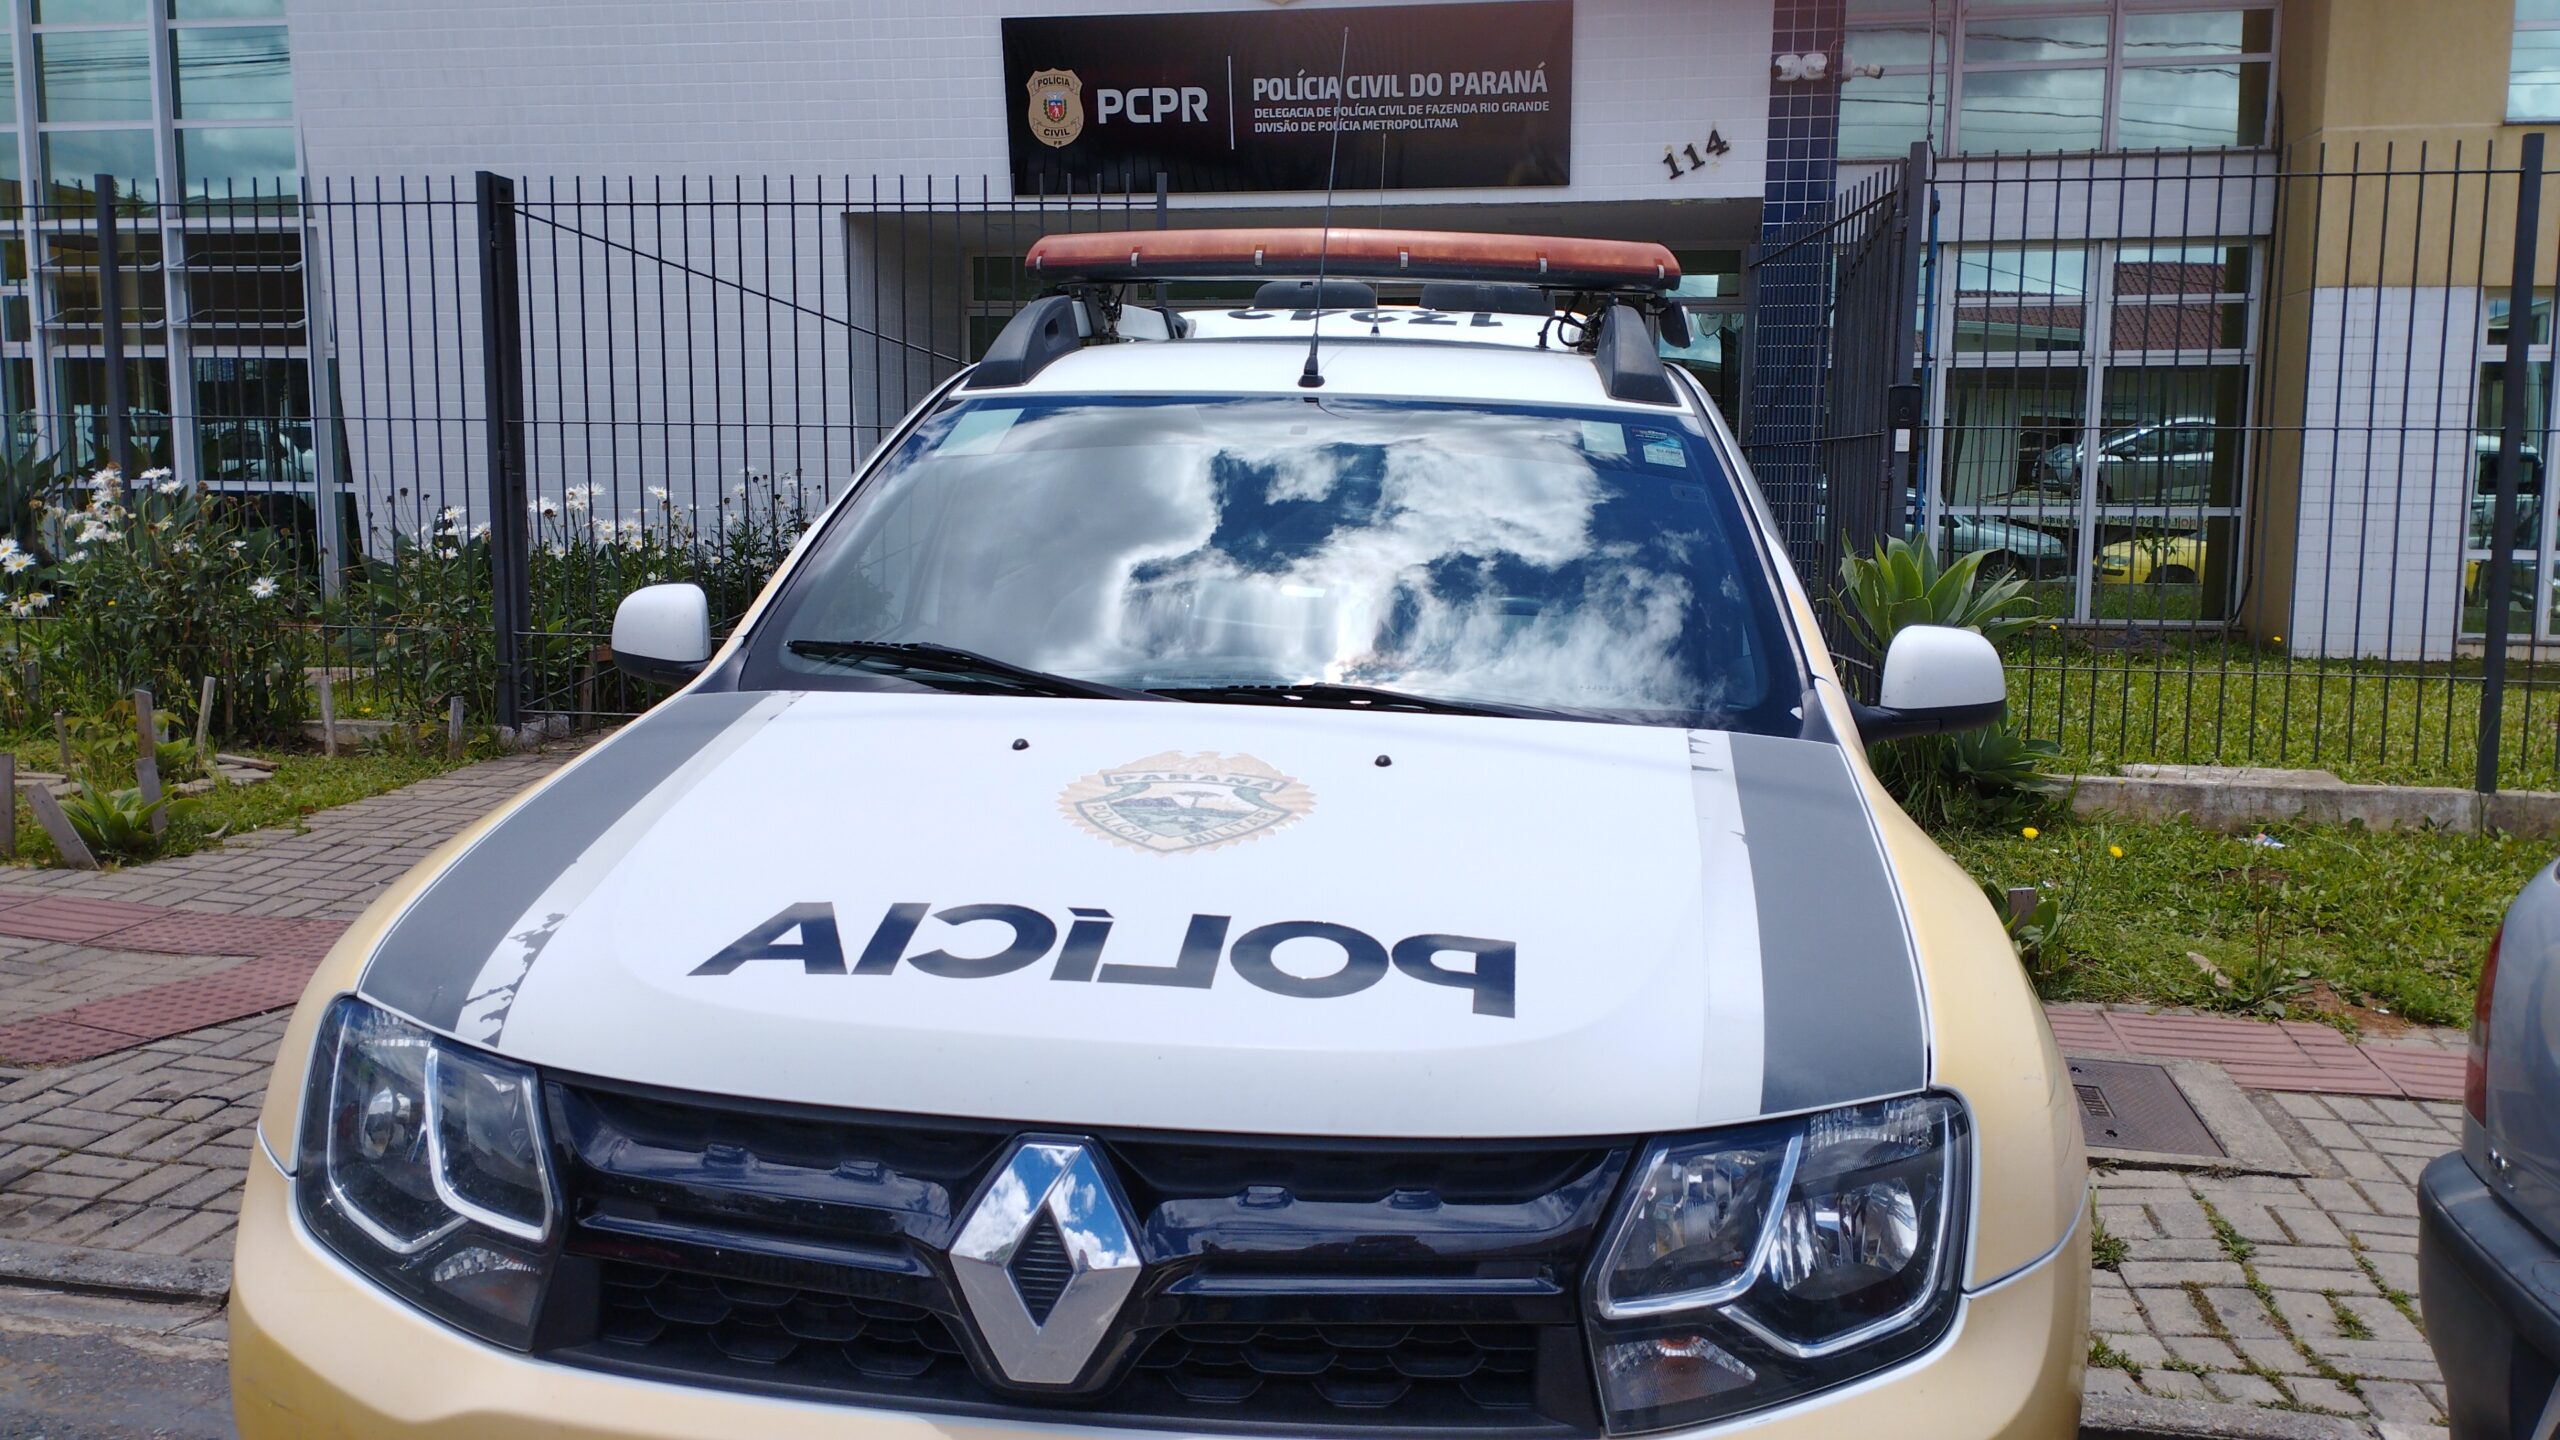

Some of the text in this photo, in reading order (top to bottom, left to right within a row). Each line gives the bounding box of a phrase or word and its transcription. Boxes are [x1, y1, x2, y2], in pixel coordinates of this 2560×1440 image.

[1037, 75, 1070, 87] POLÍCIA
[1252, 61, 1548, 101] POLÍCIA CIVIL DO PARANÁ
[1096, 86, 1209, 125] PCPR
[1254, 100, 1550, 119] DELEGACIA DE POLÍCIA CIVIL DE FAZENDA RIO GRANDE
[1043, 128, 1070, 137] CIVIL
[1254, 117, 1459, 133] DIVISÃO DE POLÍCIA METROPOLITANA
[1662, 128, 1731, 180] 114
[1182, 811, 1276, 845] MILITAR
